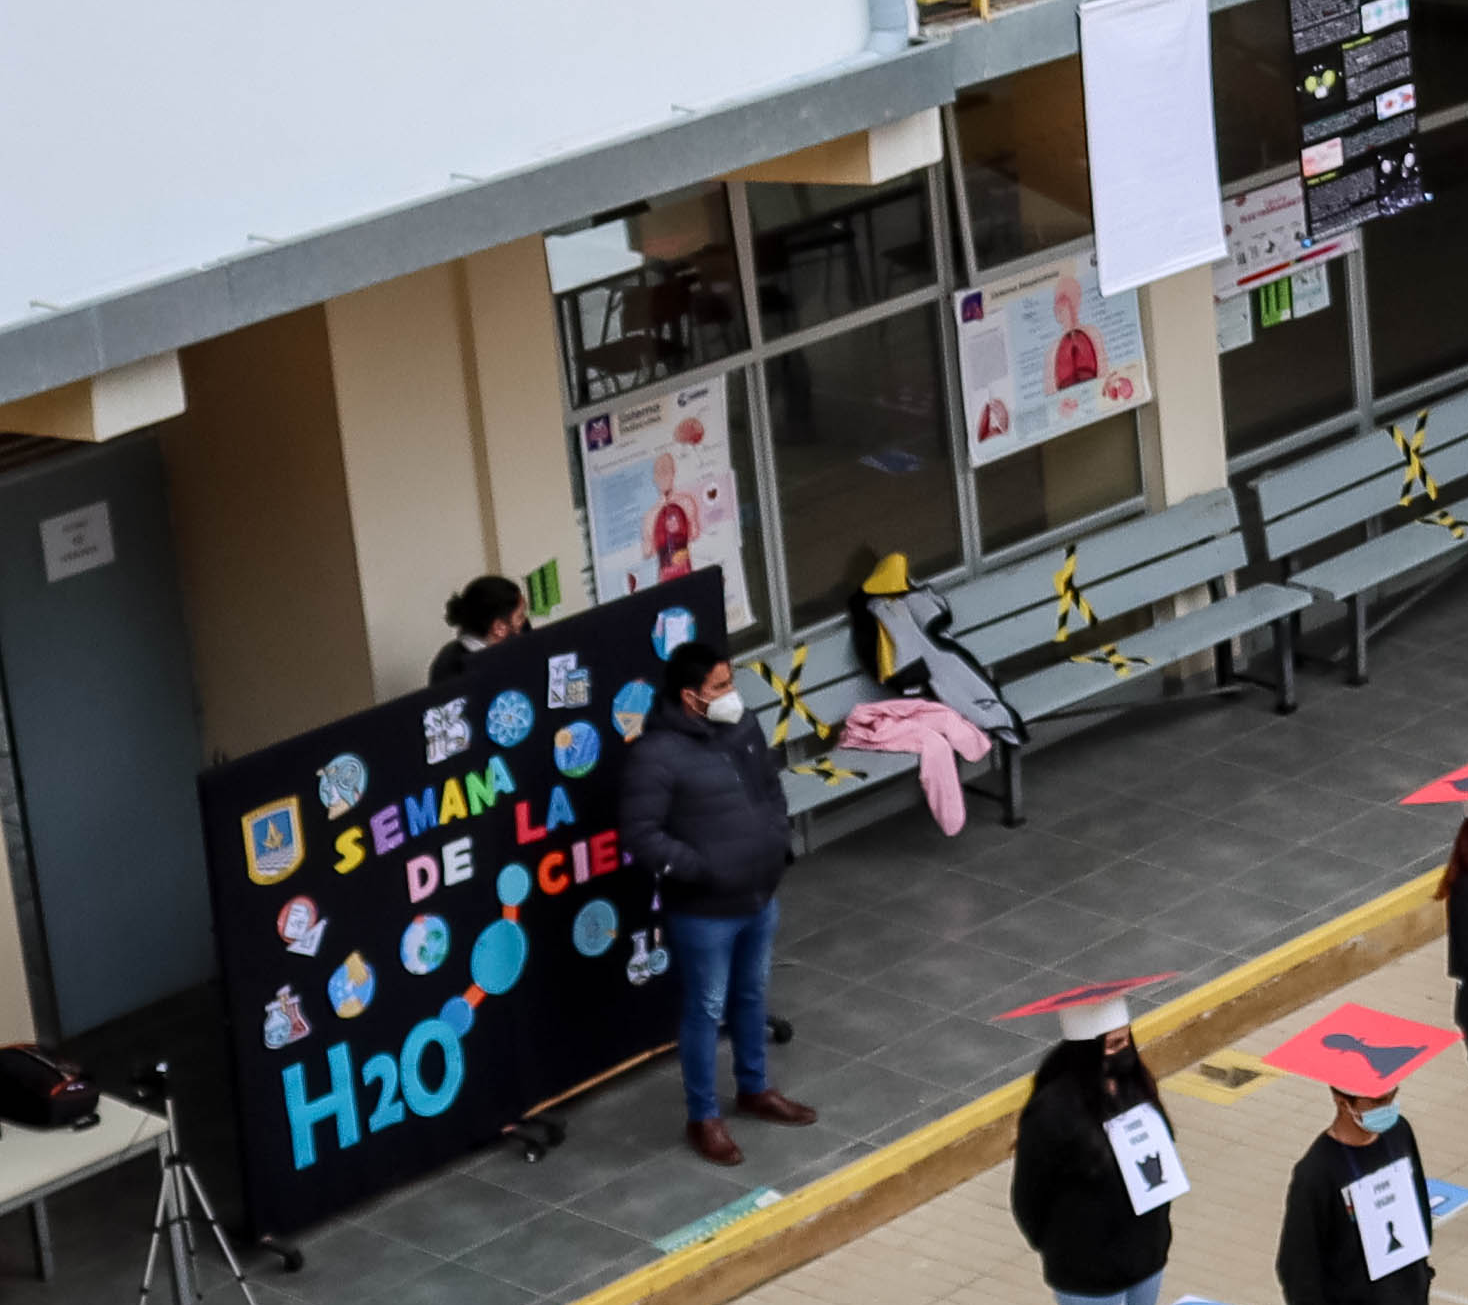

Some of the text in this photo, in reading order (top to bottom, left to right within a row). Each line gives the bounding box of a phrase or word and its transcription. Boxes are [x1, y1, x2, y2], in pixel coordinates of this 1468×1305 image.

[333, 755, 516, 875] SEMANA
[514, 785, 576, 845] LA
[406, 836, 474, 903] DE
[282, 1017, 465, 1170] H2O
